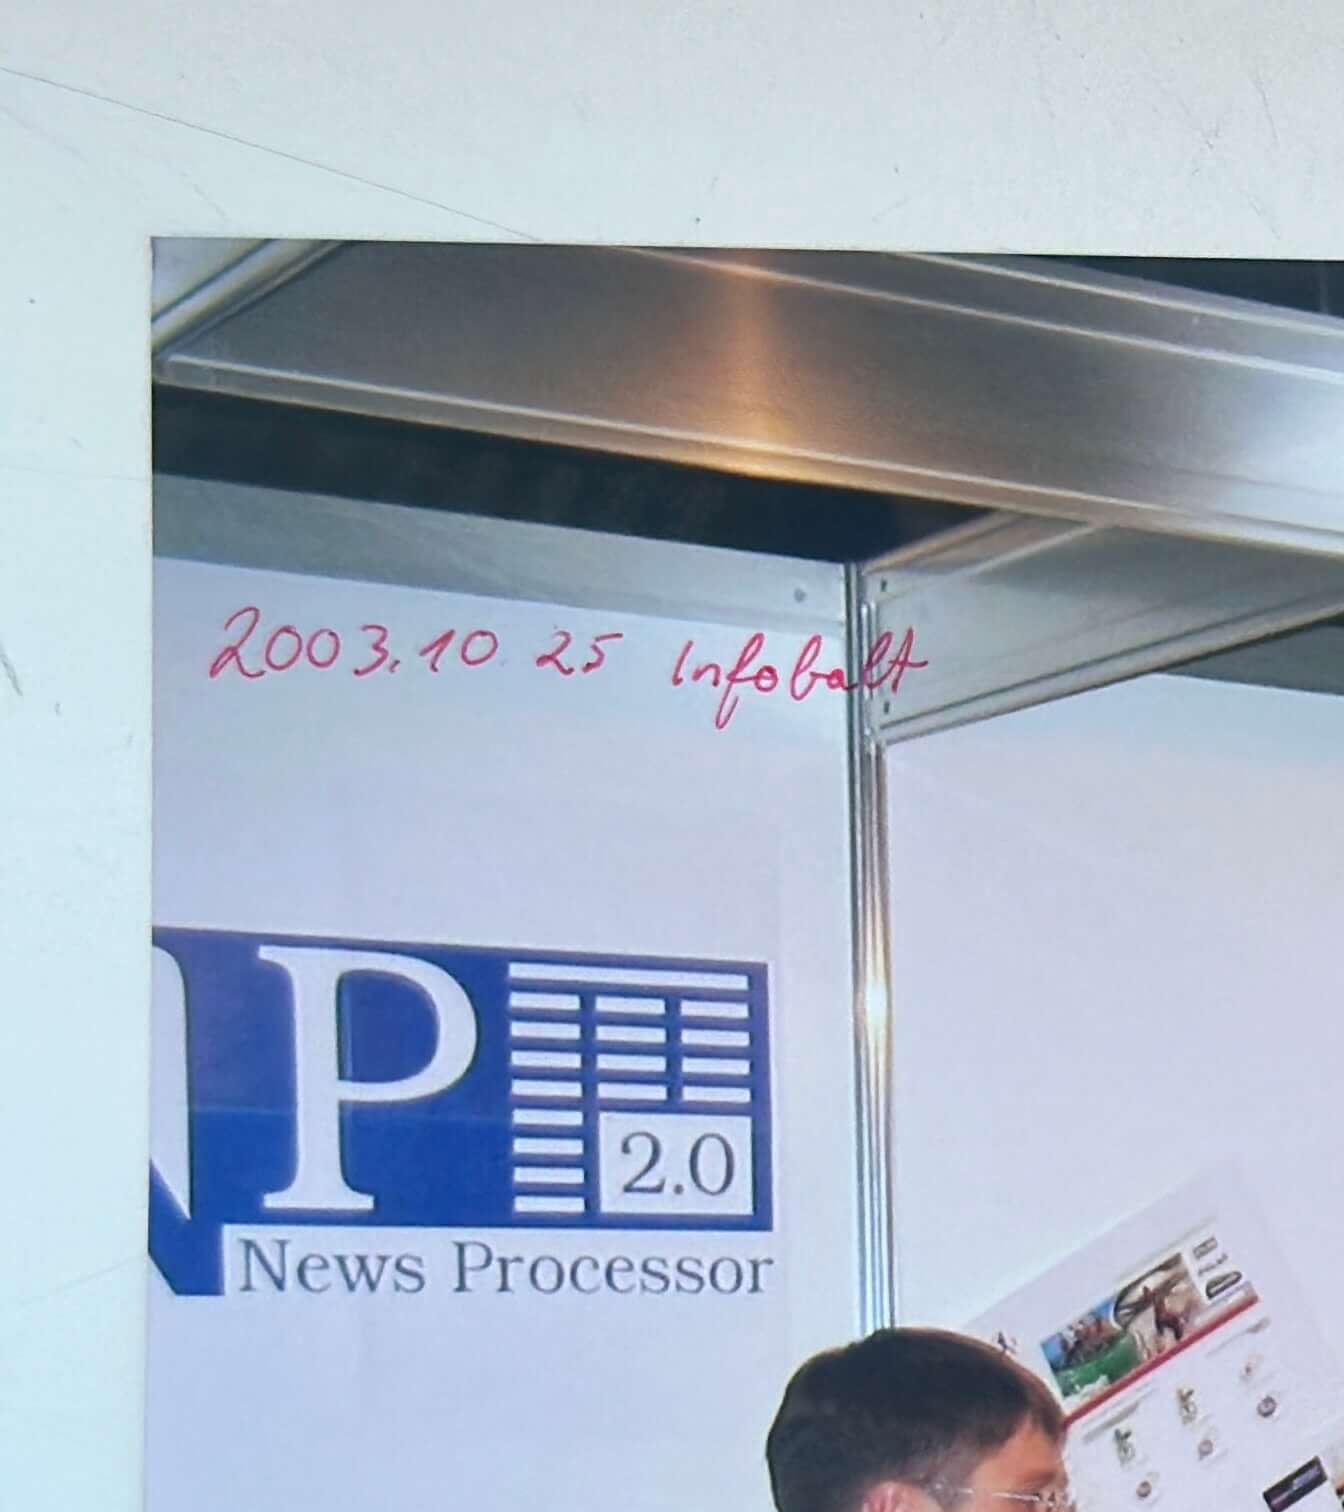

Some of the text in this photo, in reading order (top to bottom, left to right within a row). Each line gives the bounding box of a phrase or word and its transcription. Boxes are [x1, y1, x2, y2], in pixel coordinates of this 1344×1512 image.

[536, 625, 624, 676] 25
[672, 630, 929, 728] Infobalt
[619, 1130, 737, 1196] 2.0
[240, 1237, 774, 1296] News Processor
